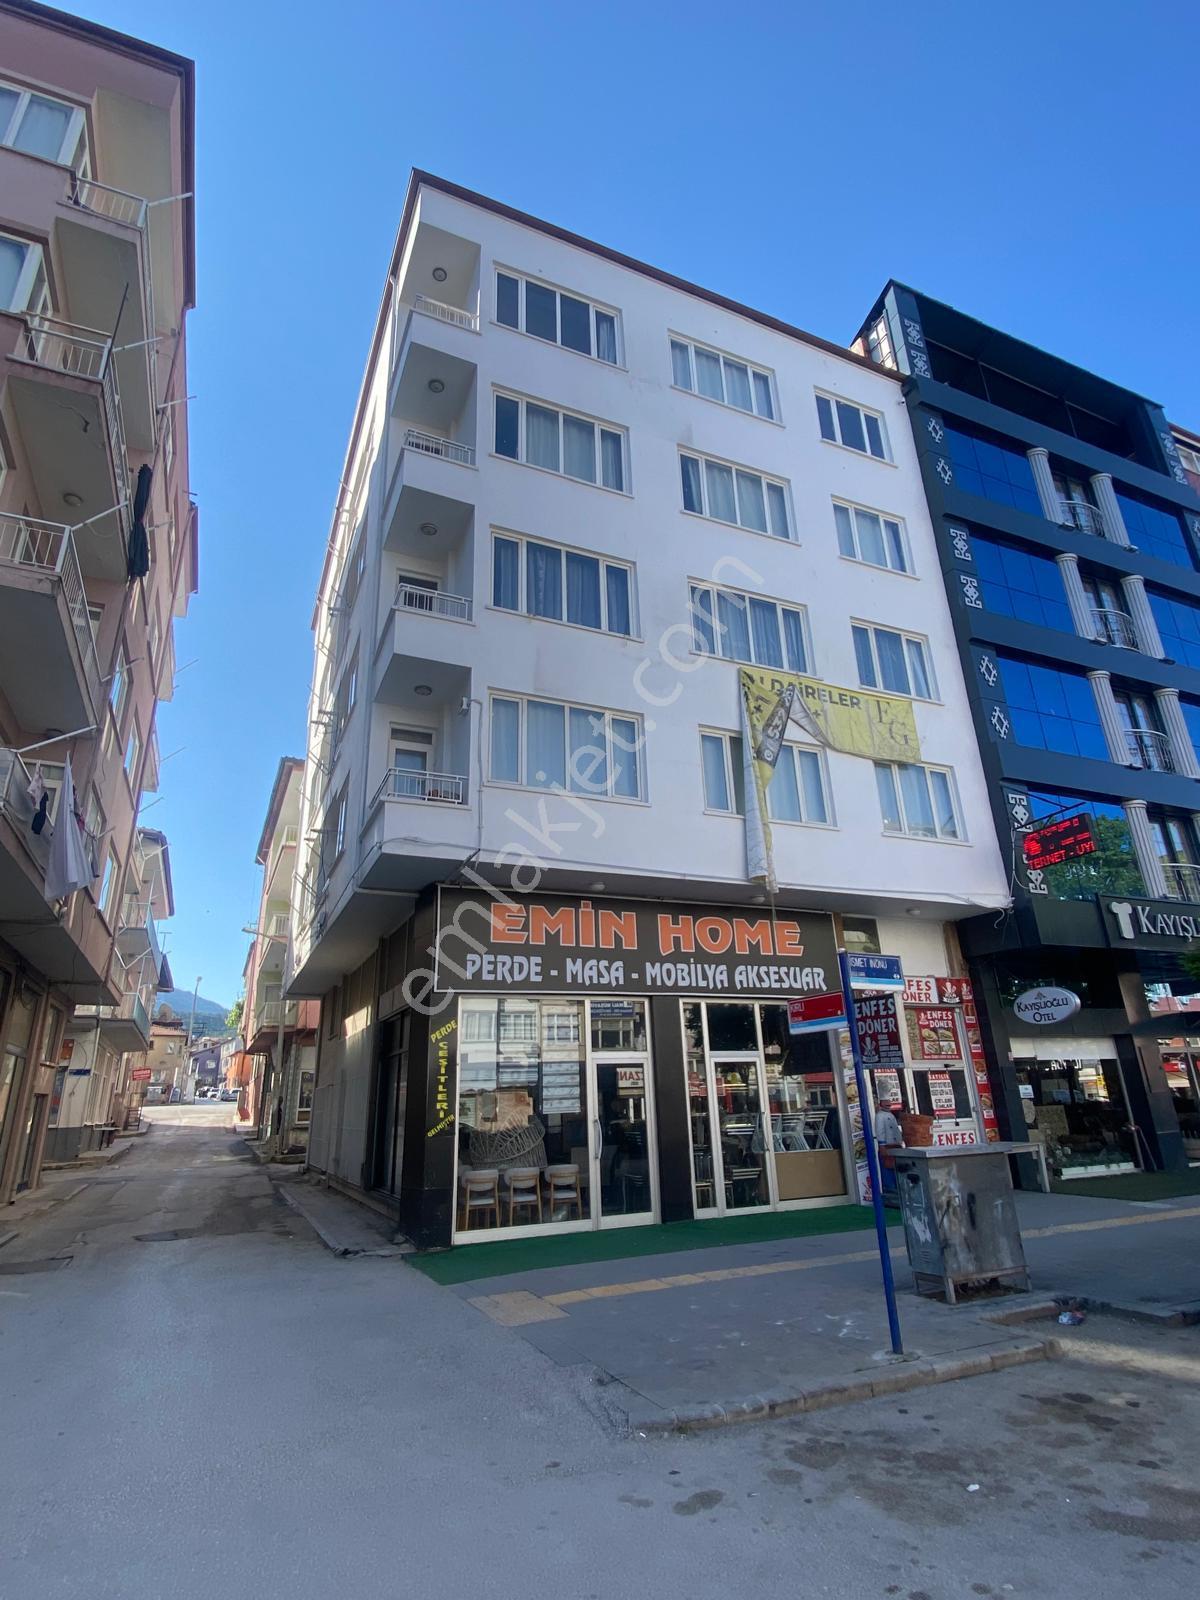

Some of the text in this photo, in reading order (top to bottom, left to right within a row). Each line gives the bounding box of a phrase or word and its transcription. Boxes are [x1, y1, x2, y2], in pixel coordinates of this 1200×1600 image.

[491, 900, 804, 956] EMİN HOME
[466, 953, 543, 984] PERDE
[566, 958, 624, 987] MASA
[645, 958, 728, 990] MOBİLYA
[734, 965, 827, 991] AKSESUAR
[854, 997, 896, 1019] ENFES
[926, 1010, 953, 1020] ENFES
[1033, 1011, 1057, 1023] OTEL
[430, 1019, 458, 1043] PERDE
[857, 1017, 897, 1036] DÖNER
[929, 1019, 953, 1028] DÖNER
[937, 1132, 975, 1146] ENFES
